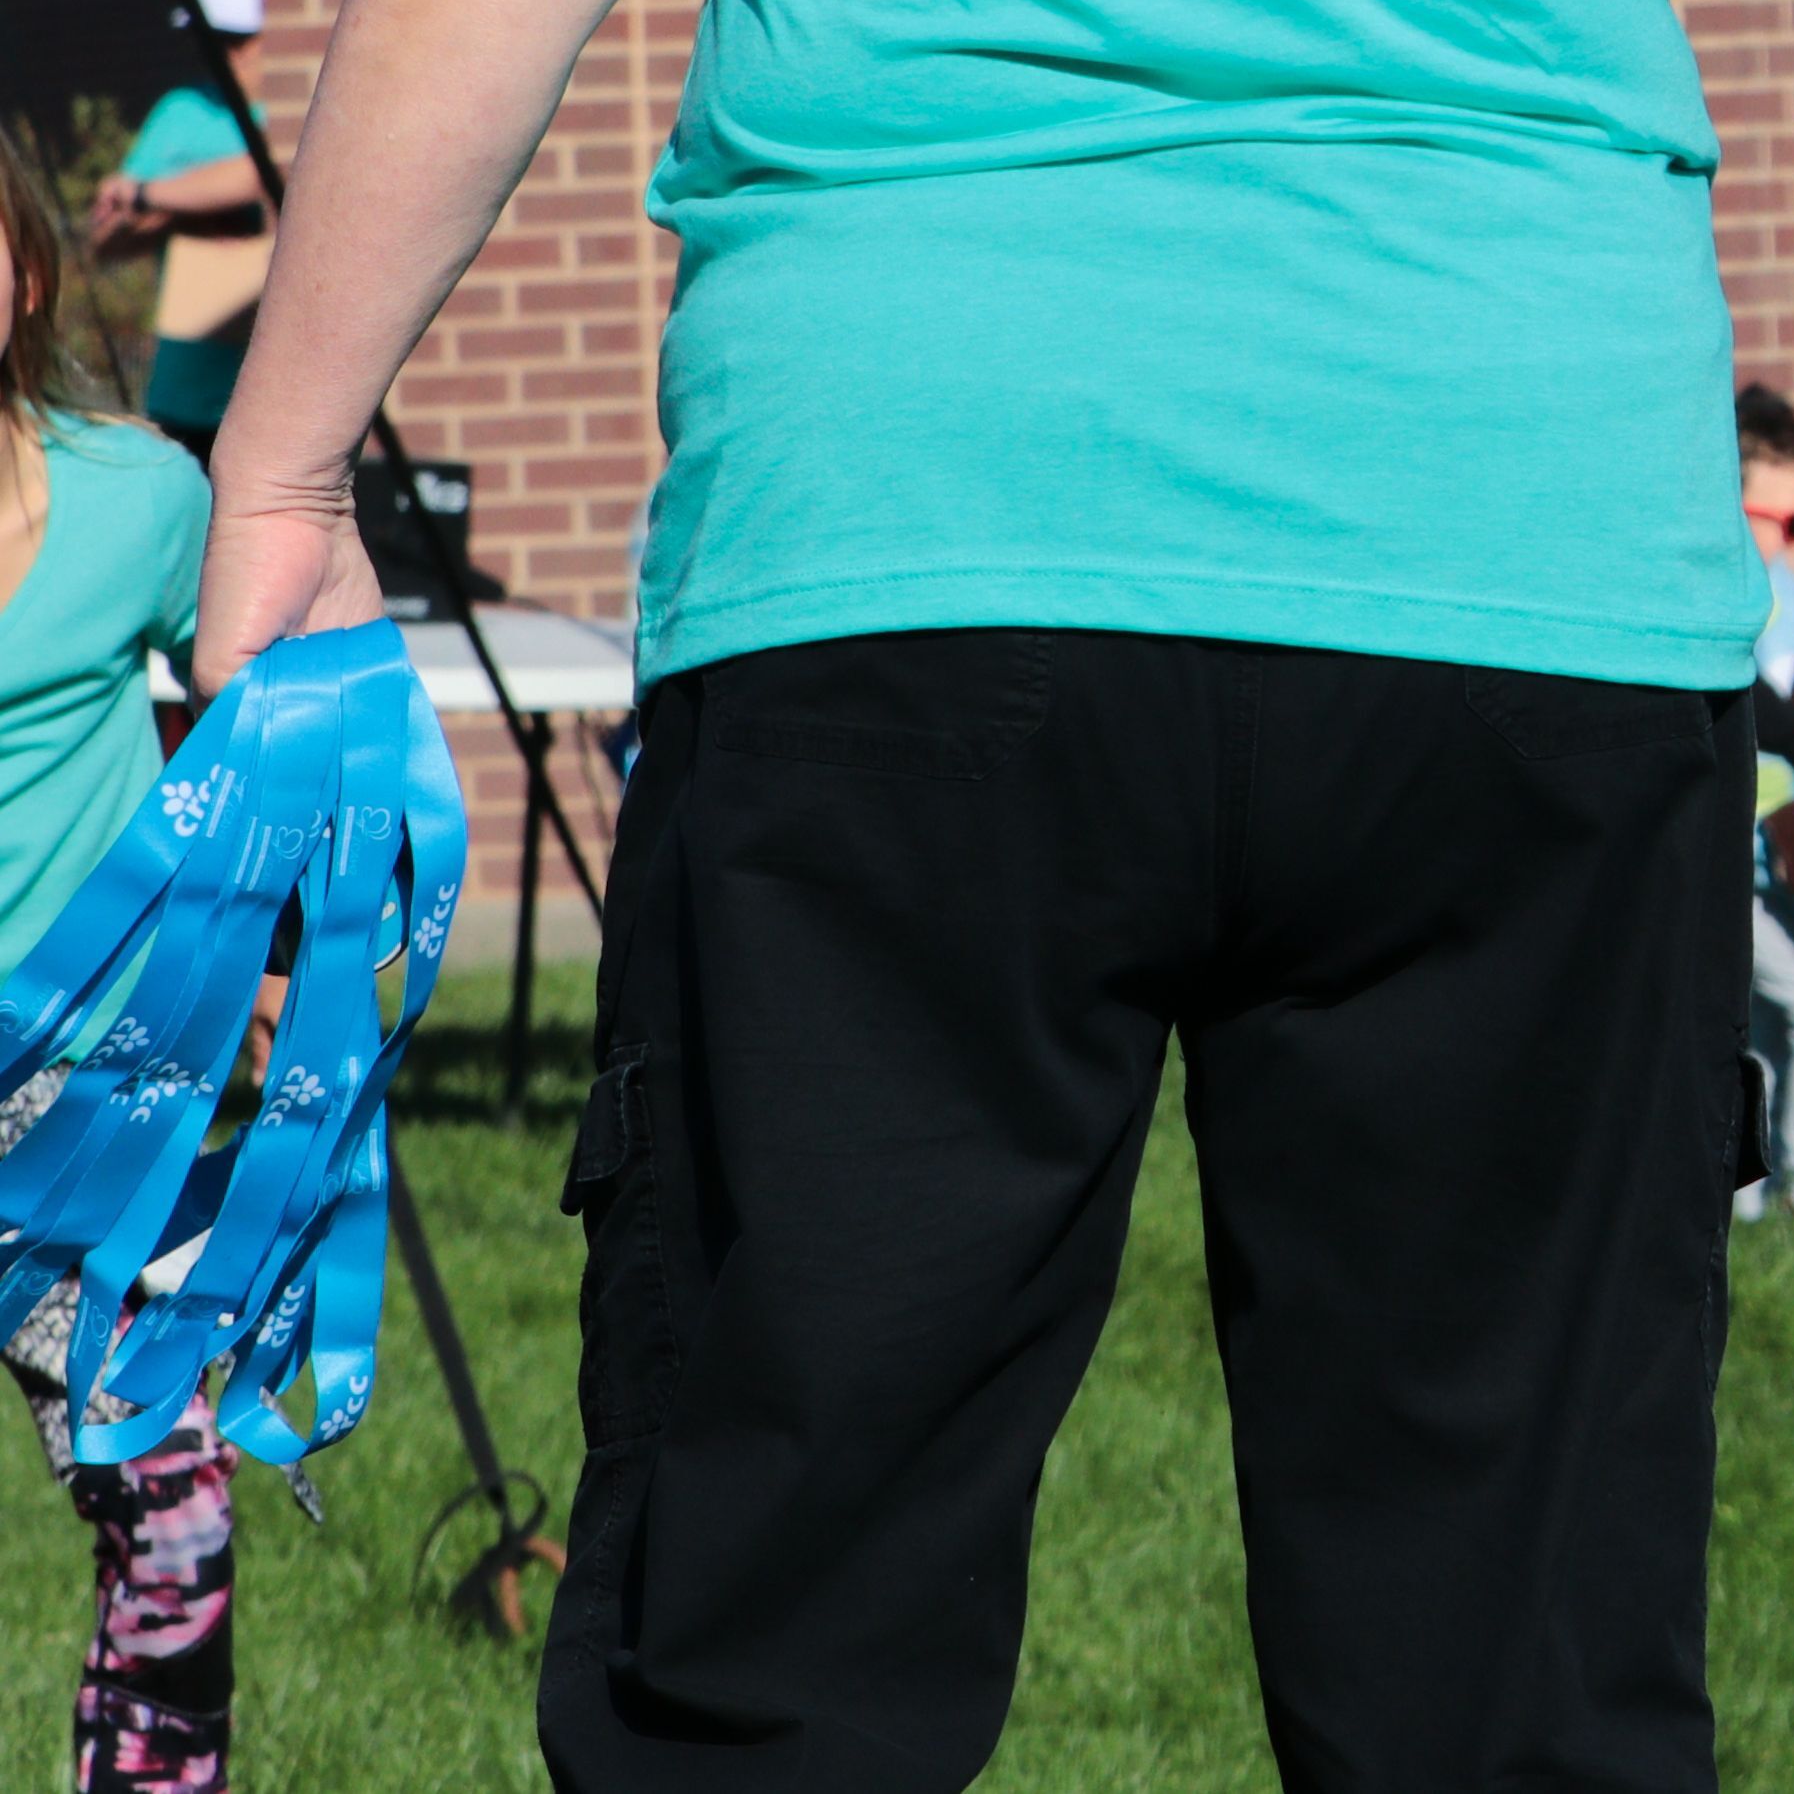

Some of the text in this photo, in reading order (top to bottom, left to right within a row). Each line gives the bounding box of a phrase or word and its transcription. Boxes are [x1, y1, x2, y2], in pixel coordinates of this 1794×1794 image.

[427, 883, 457, 960] crcc
[262, 1065, 306, 1127] crcc
[271, 1285, 306, 1349] crcc
